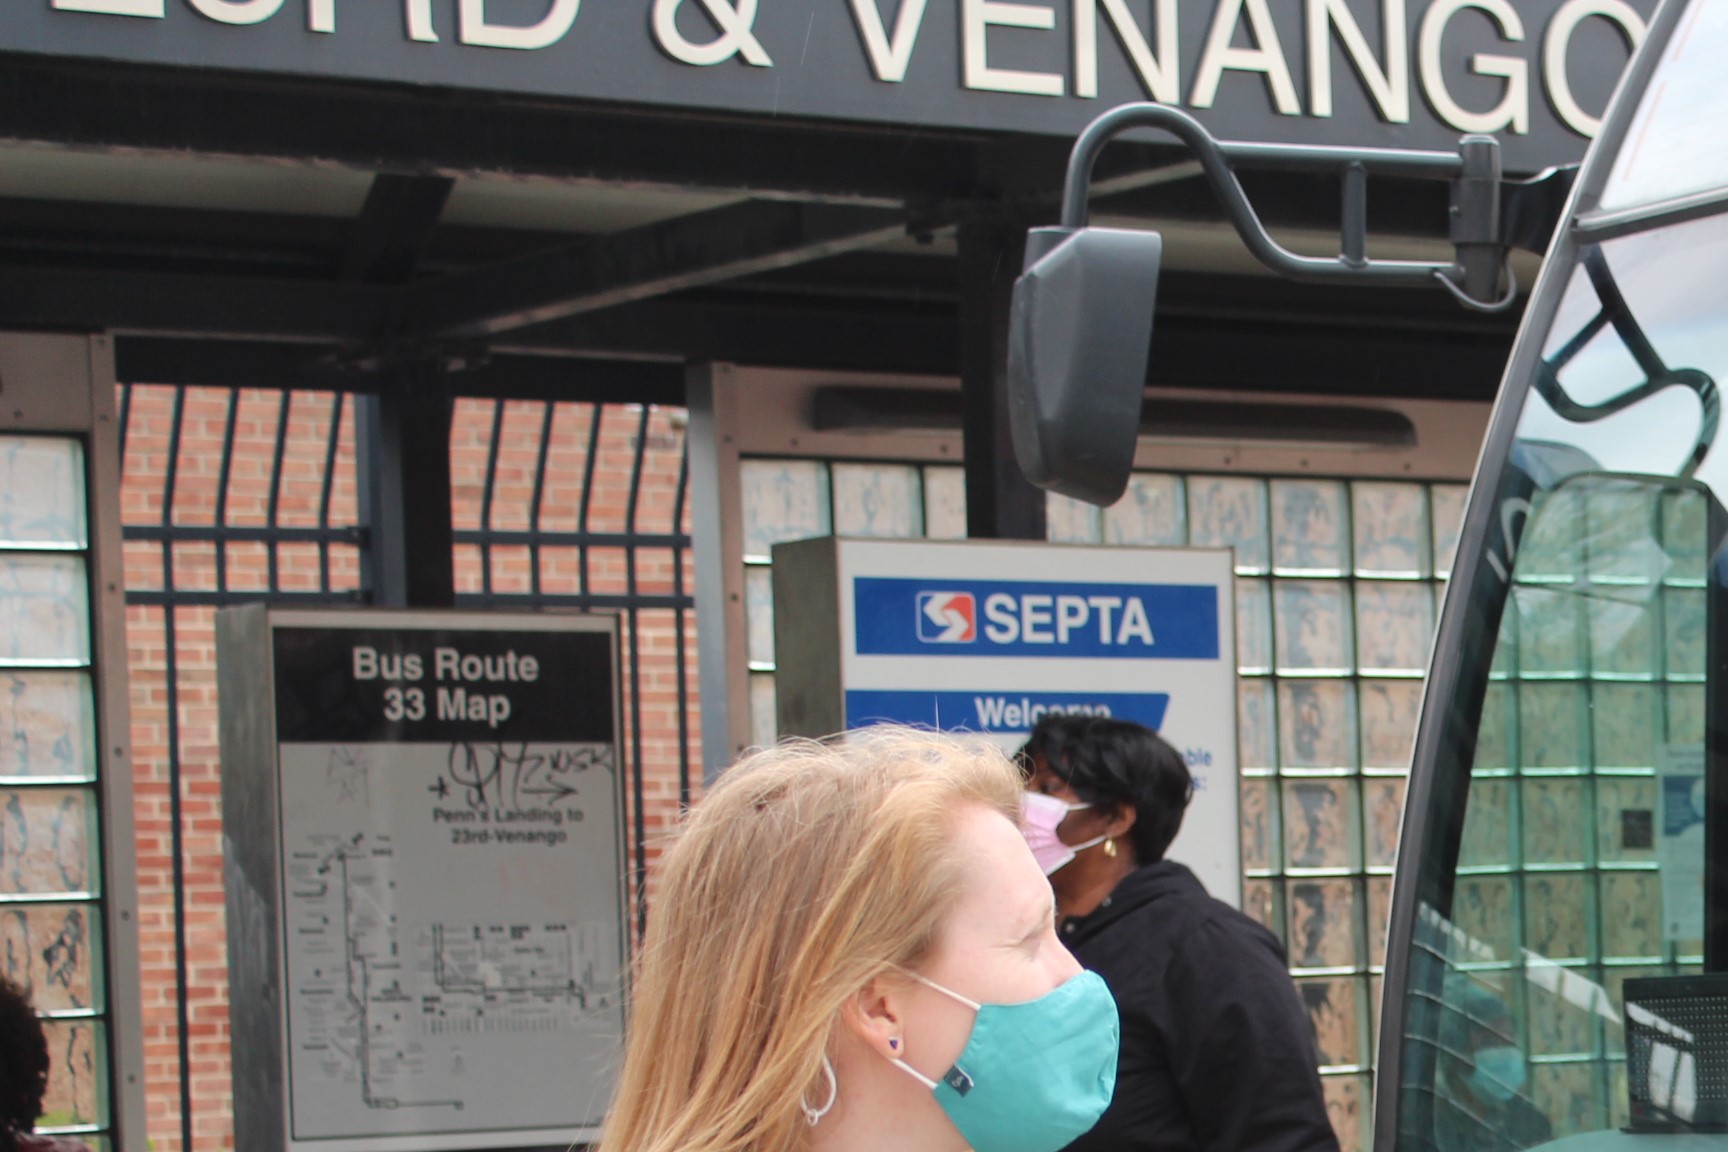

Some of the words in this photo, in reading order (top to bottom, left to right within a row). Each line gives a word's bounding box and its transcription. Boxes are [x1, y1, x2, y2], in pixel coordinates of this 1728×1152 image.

[984, 592, 1156, 645] SEPTA
[352, 646, 424, 681] Bus
[434, 646, 540, 682] Route
[383, 687, 427, 722] 33
[436, 687, 512, 729] Map
[495, 807, 563, 825] Landing
[566, 807, 585, 822] to
[451, 828, 567, 847] 23rd-Venango
